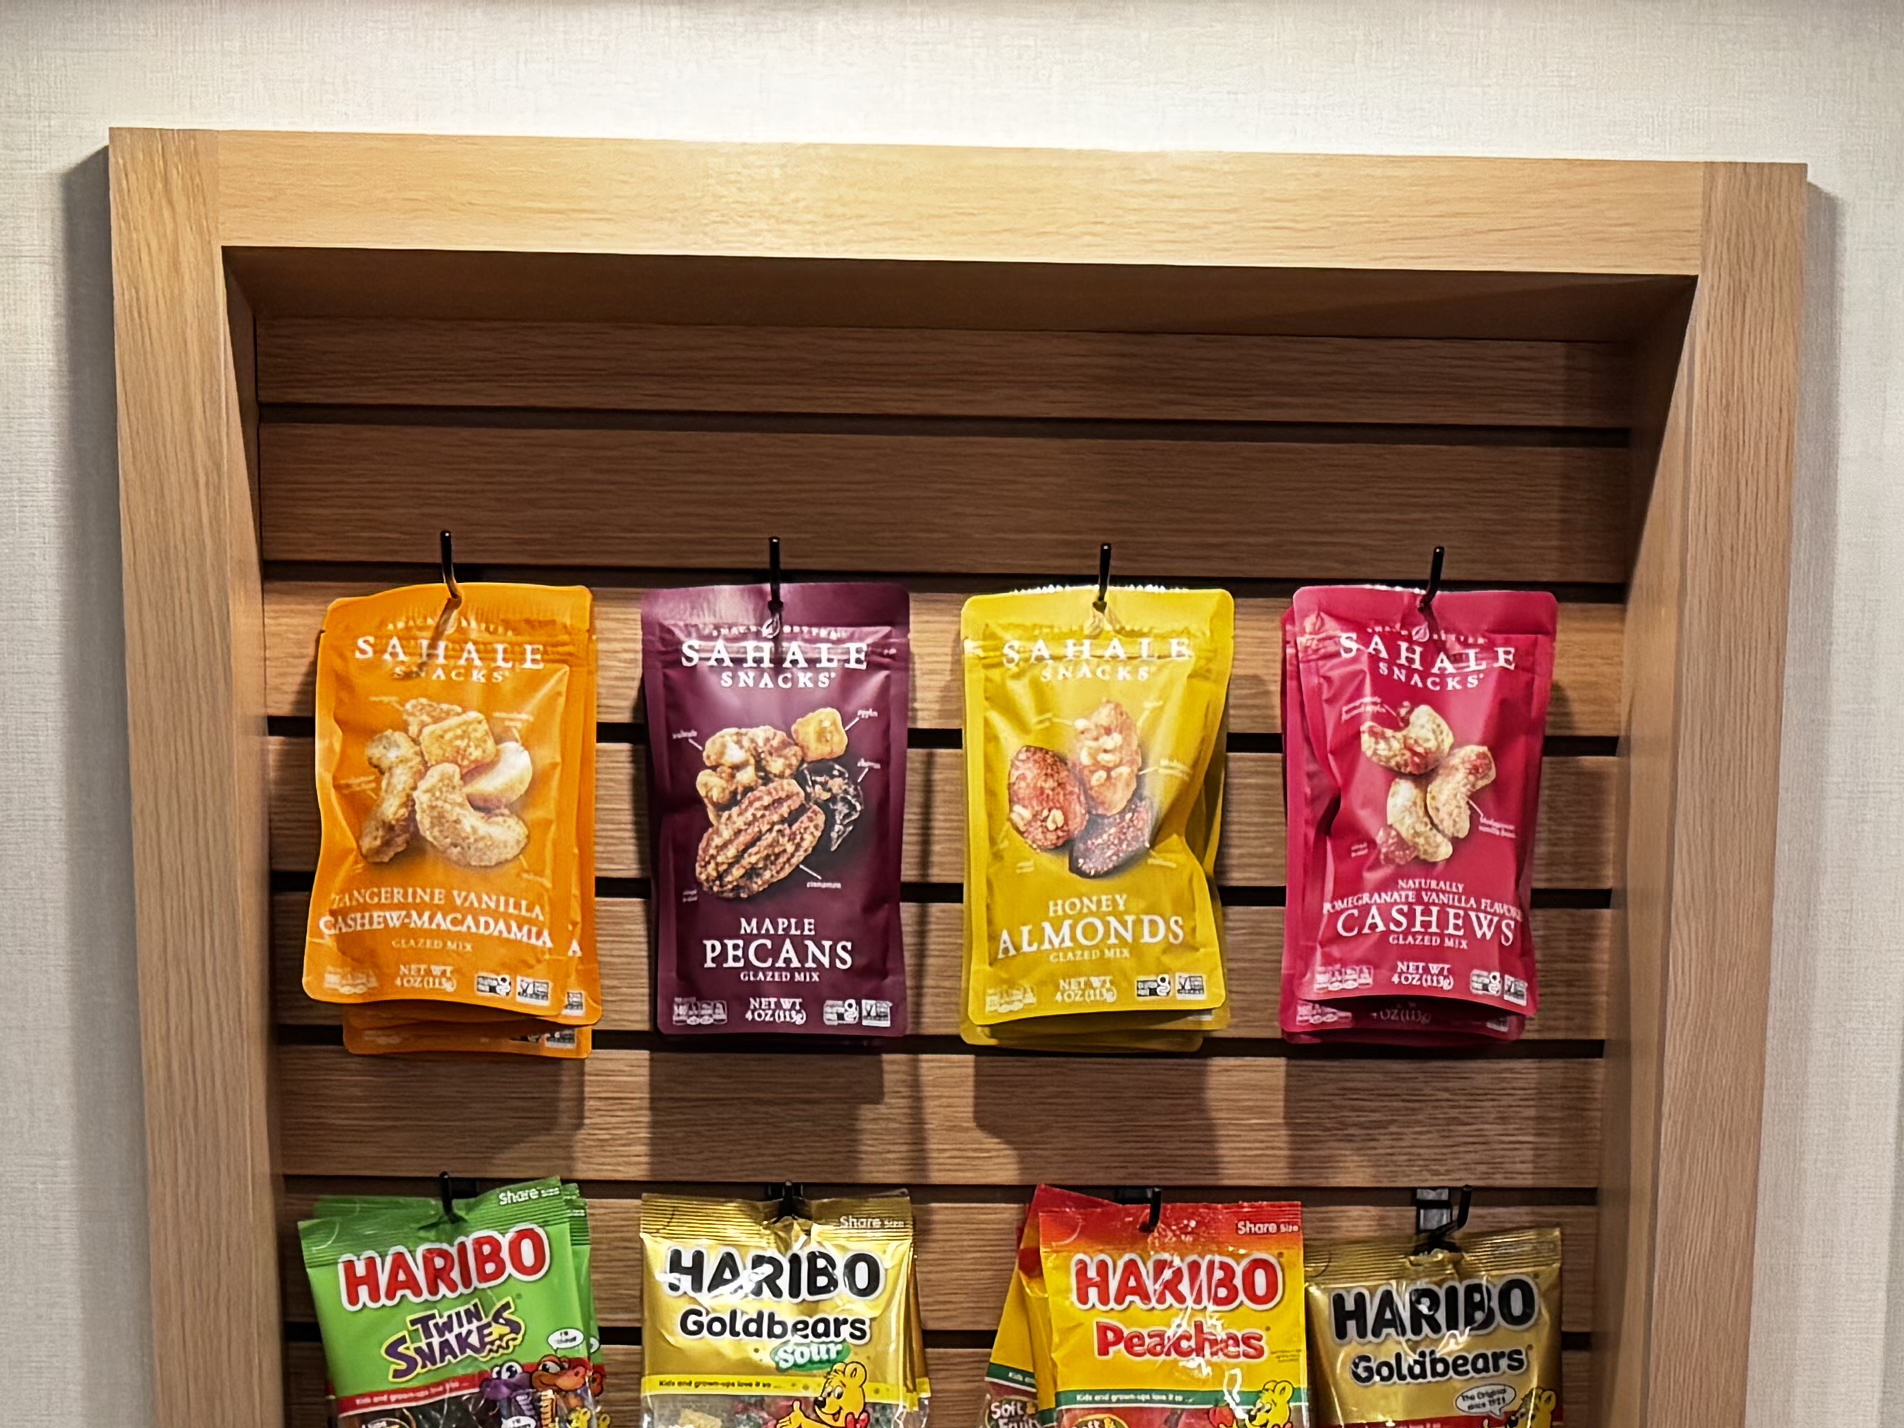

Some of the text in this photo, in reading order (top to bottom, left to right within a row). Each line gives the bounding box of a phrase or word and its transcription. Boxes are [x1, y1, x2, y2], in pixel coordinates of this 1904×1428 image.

[355, 635, 546, 671] SAHALE
[681, 641, 868, 670] SAHALE
[1003, 640, 1193, 666] SAHALE
[1339, 632, 1516, 672] SAHALE
[720, 671, 831, 688] SNACKS
[1379, 662, 1478, 690] SNACKS
[1398, 880, 1464, 892] NATURALLY
[330, 888, 545, 920] TANGERINE VANILLA
[1048, 894, 1128, 918] HONEY
[740, 918, 816, 935] MAPLE
[996, 915, 1185, 959] ALMONDS
[1336, 906, 1515, 946] CASHEWS
[704, 940, 853, 969] PECANS
[740, 971, 820, 982] GLAZED MIX
[749, 998, 803, 1010] NET WT
[340, 1227, 548, 1307] HARIBO
[667, 1249, 883, 1300] HARIBO
[1073, 1254, 1285, 1310] HARIBO
[410, 1301, 481, 1340] TWIN
[680, 1309, 870, 1344] Goldbears
[1332, 1277, 1538, 1343] HARIBO
[774, 1342, 845, 1371] Sour
[1096, 1322, 1265, 1360] Peaches
[1351, 1348, 1525, 1384] Goldbears
